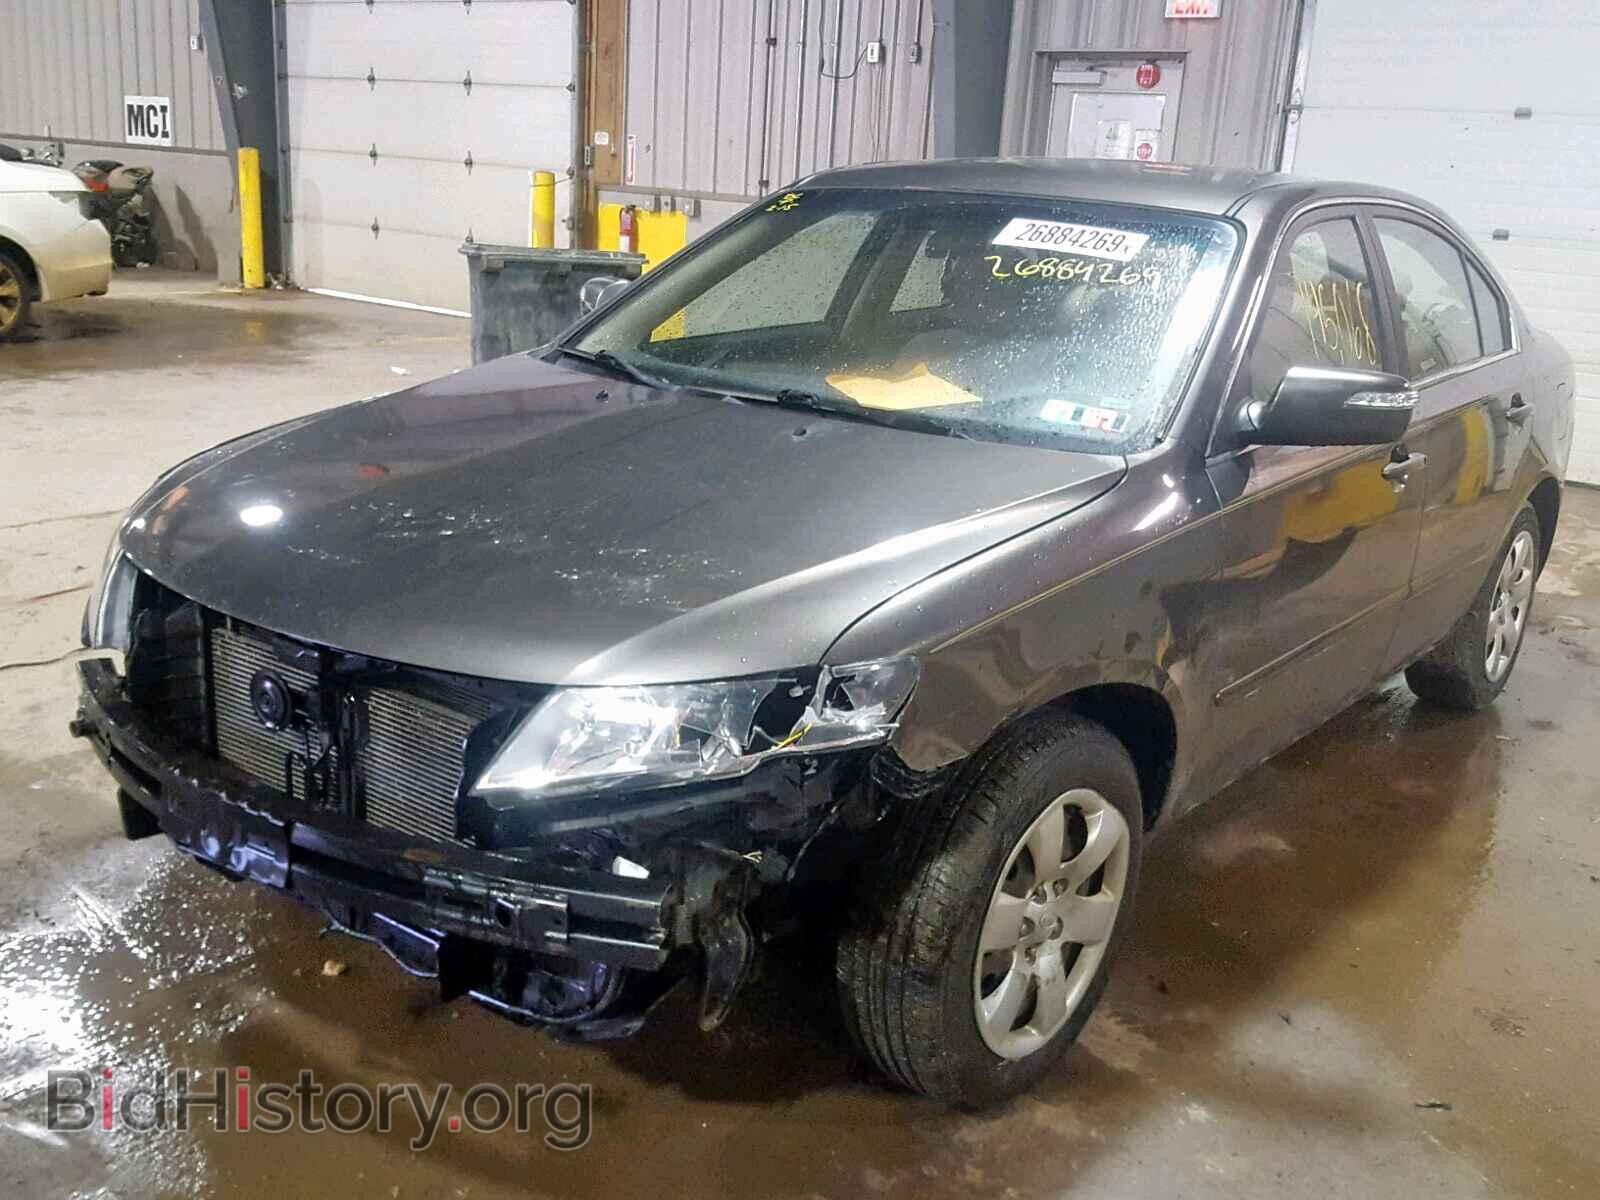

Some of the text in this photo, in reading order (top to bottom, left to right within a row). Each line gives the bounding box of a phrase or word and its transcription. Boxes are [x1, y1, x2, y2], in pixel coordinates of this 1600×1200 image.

[126, 103, 170, 138] MCI
[1016, 222, 1127, 253] 26884269
[984, 255, 1162, 289] 26884269
